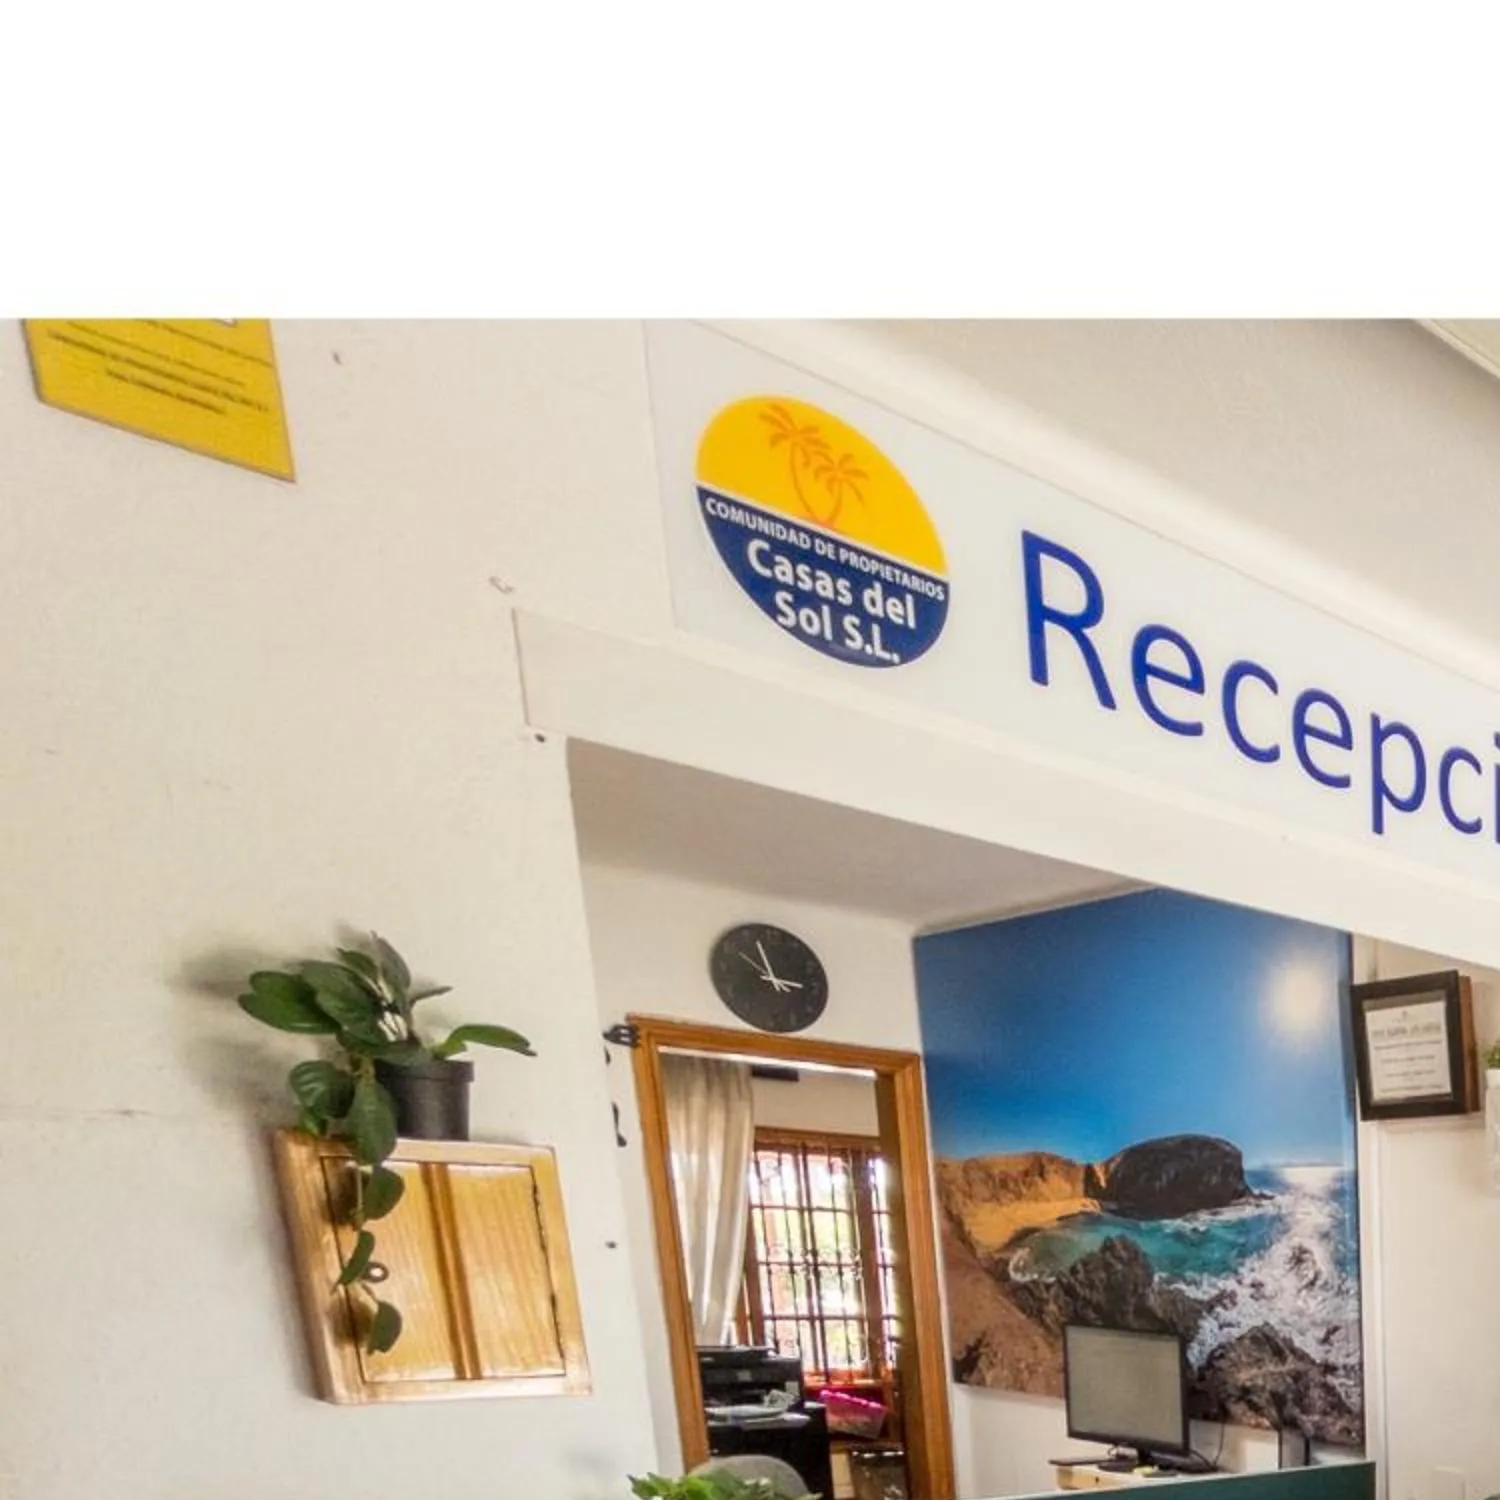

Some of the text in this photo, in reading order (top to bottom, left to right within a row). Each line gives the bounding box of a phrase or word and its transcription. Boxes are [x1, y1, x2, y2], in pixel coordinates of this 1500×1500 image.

[705, 497, 946, 601] COMUNIDAD DE PROPIETARIOS
[747, 538, 917, 630] Casas del
[774, 590, 900, 665] Sol S.L.
